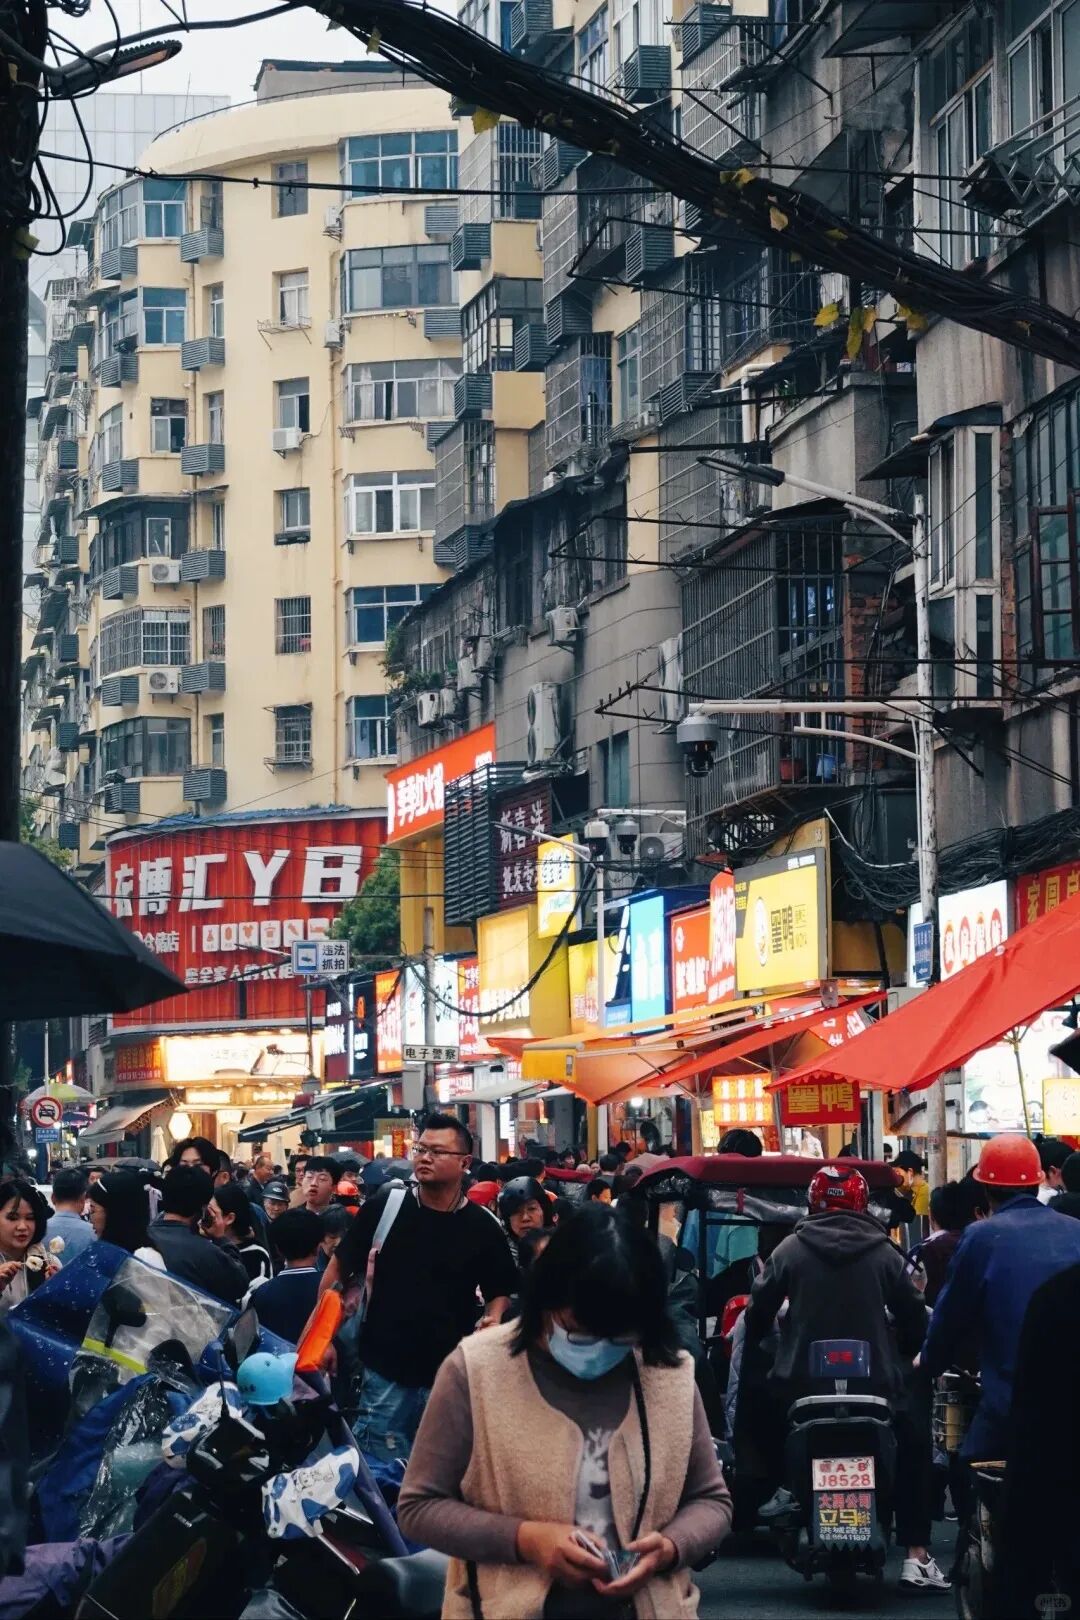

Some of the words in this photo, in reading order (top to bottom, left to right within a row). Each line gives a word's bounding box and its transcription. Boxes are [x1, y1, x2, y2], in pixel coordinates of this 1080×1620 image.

[322, 945, 345, 956] 违法
[322, 958, 345, 970] 抓拍
[406, 1047, 456, 1060] 电子警察
[818, 1473, 871, 1487] J8528
